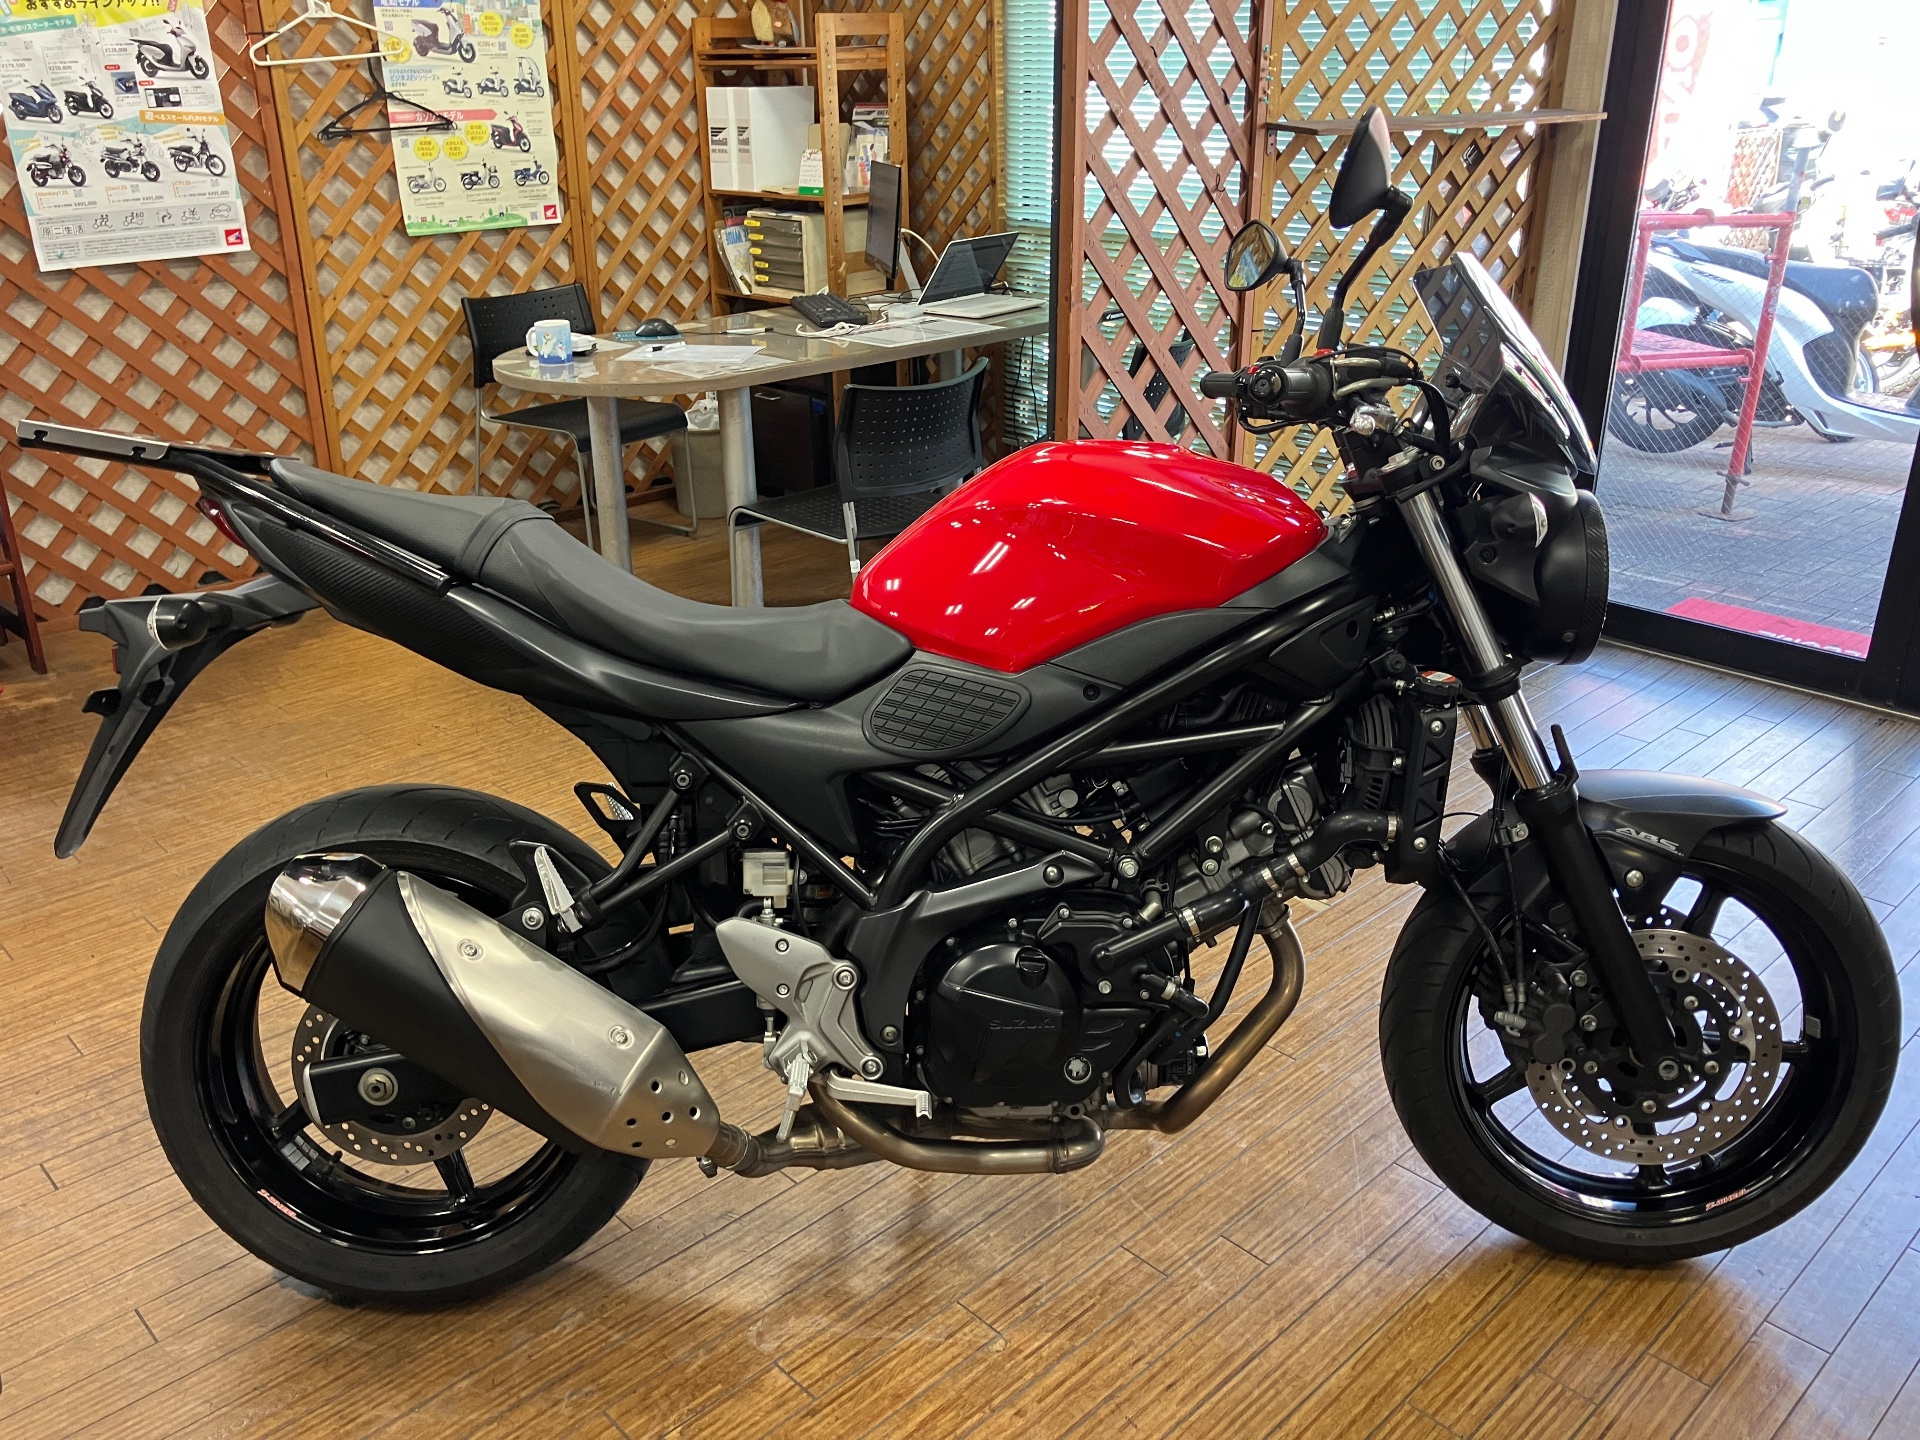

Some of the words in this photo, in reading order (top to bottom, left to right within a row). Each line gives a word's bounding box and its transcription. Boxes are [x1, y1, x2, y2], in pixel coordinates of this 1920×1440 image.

[144, 111, 219, 122] 遊べるスモールFUNモデル
[42, 226, 85, 237] 原二生活
[1615, 827, 1680, 852] ABS
[989, 1018, 1056, 1030] SUZUKI
